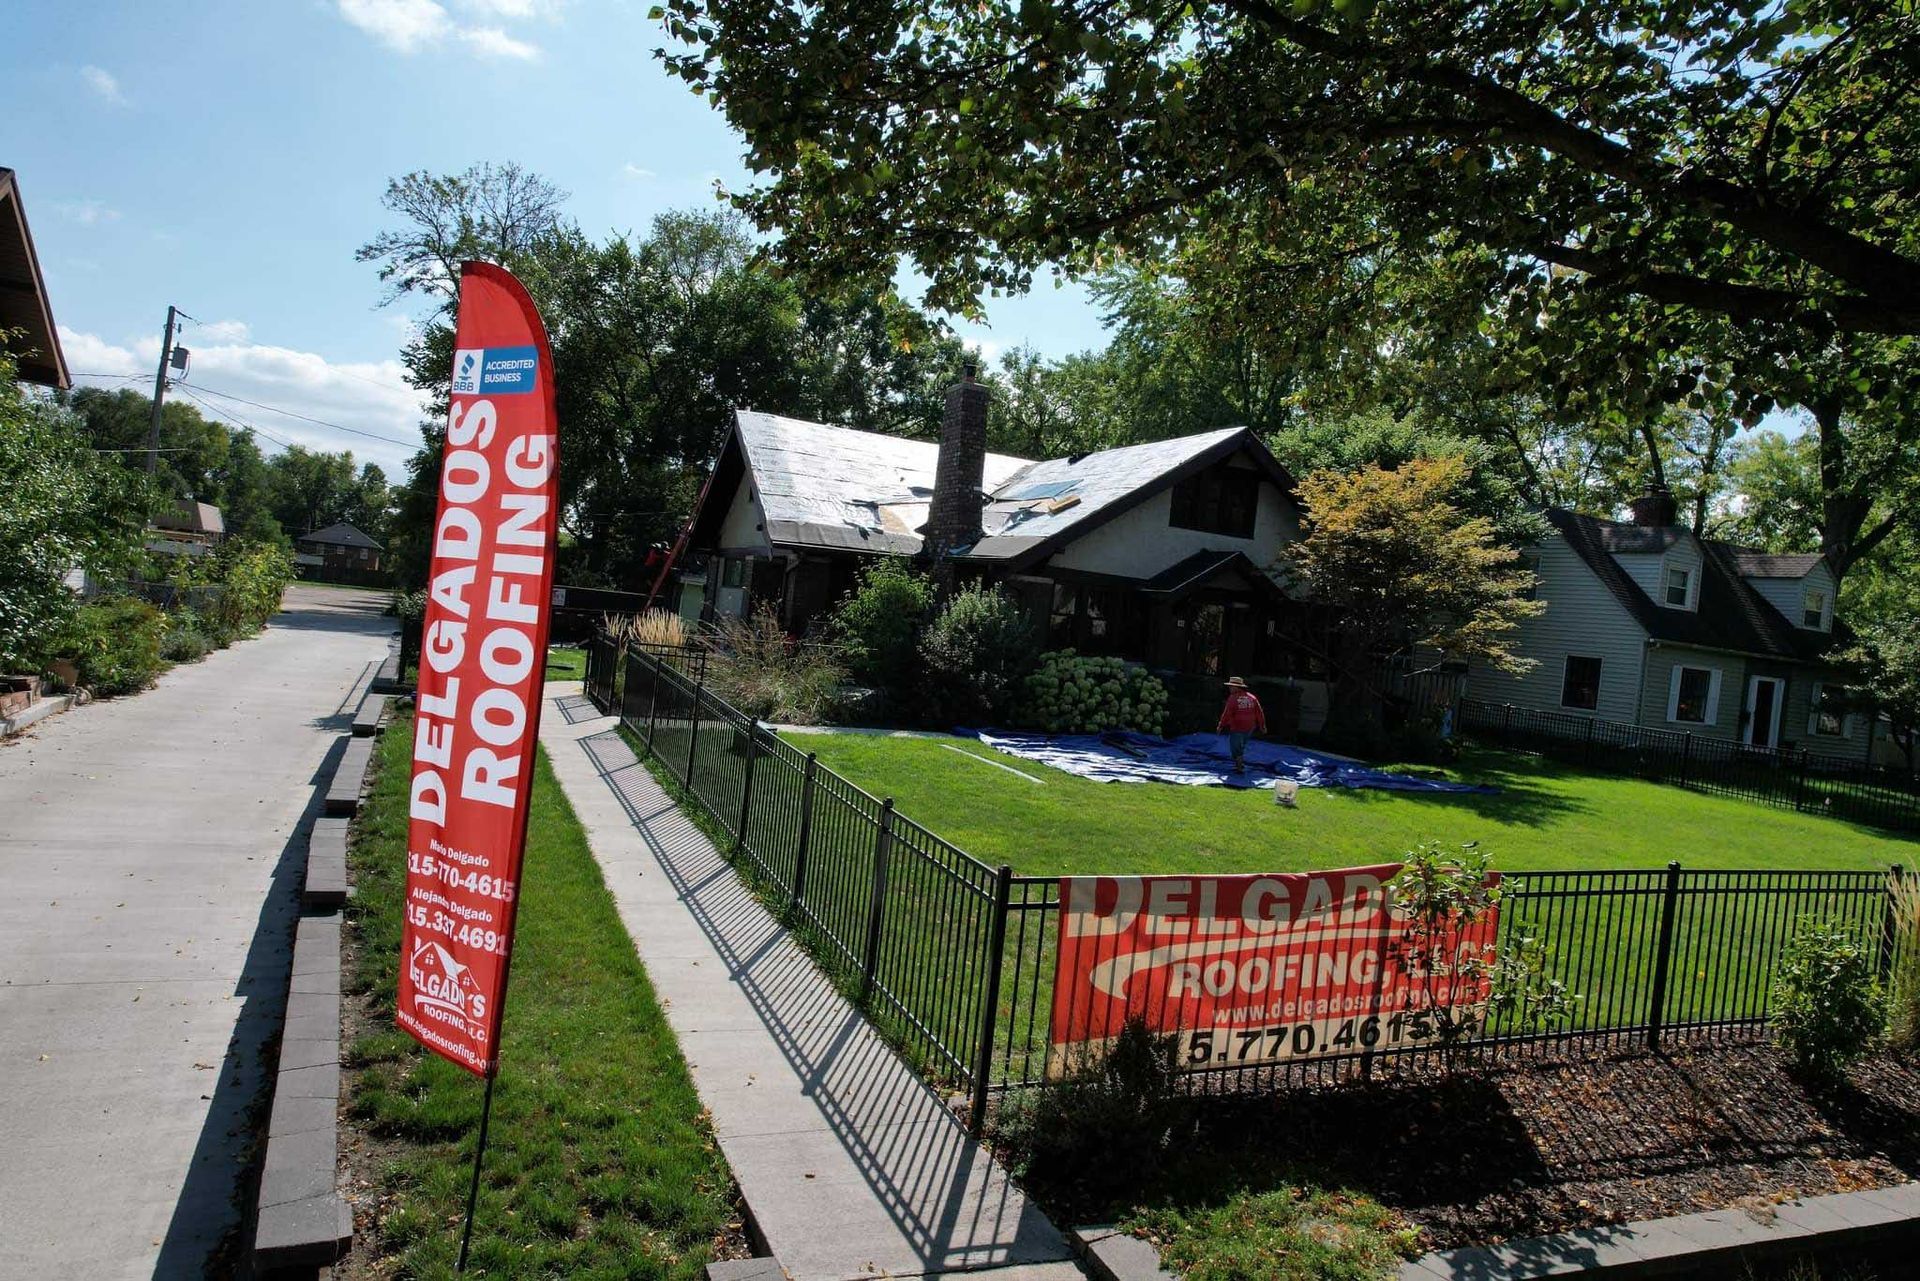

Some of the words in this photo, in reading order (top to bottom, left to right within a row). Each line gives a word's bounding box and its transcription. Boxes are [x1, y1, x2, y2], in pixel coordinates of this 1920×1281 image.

[485, 373, 522, 383] BUSINESS
[486, 360, 535, 371] ACCREDITED
[454, 381, 474, 391] BBB
[410, 399, 497, 827] DELGADOS
[461, 434, 556, 808] ROOFING
[448, 847, 490, 867] Delgado
[407, 850, 515, 902] 15-770-4615
[450, 901, 493, 923] Delgado
[407, 898, 508, 957] 15.337.4691
[424, 1003, 467, 1034] ROOFING,
